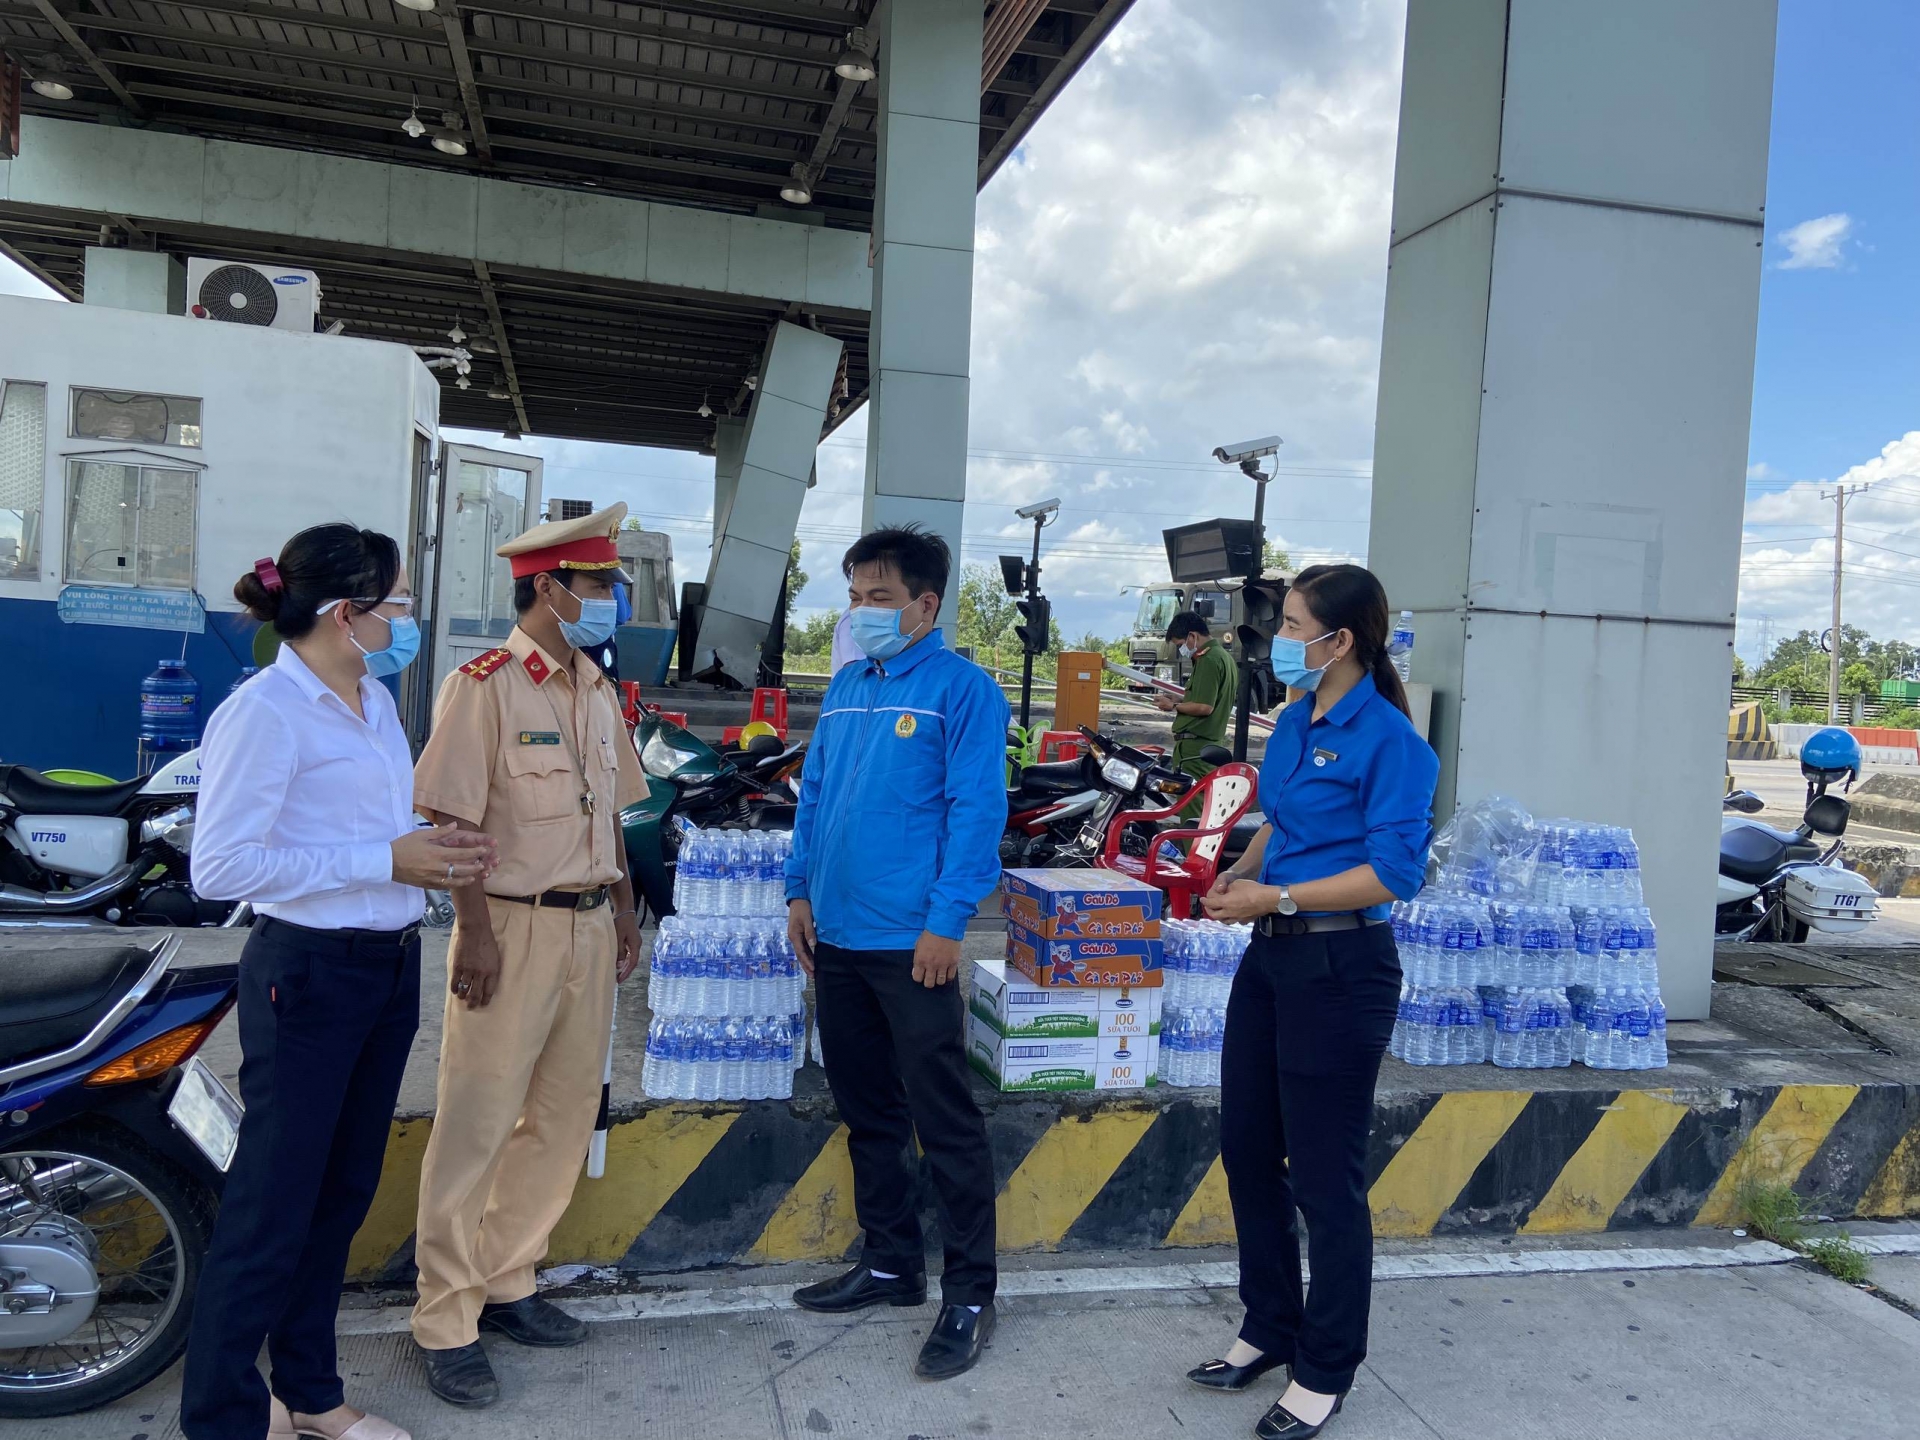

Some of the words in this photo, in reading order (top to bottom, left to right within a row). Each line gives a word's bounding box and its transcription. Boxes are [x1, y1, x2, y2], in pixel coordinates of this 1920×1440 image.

[84, 591, 110, 600] LÒNG
[112, 593, 137, 603] KIỂM
[162, 598, 183, 606] TIỀN
[80, 601, 110, 610] TRƯỚC
[131, 605, 146, 613] RỜI
[31, 832, 66, 843] VT750
[1083, 892, 1104, 905] Gấu
[1104, 893, 1119, 905] Đỏ
[1834, 894, 1861, 906] TTGT
[1088, 922, 1102, 934] Gà
[1105, 922, 1121, 936] Sợi
[1123, 922, 1144, 935] Phở
[1079, 942, 1102, 954] Gấu
[1102, 943, 1117, 954] Đỏ
[1084, 971, 1100, 984] Gà
[1102, 971, 1119, 986] Sợi
[1121, 971, 1143, 984] Phở
